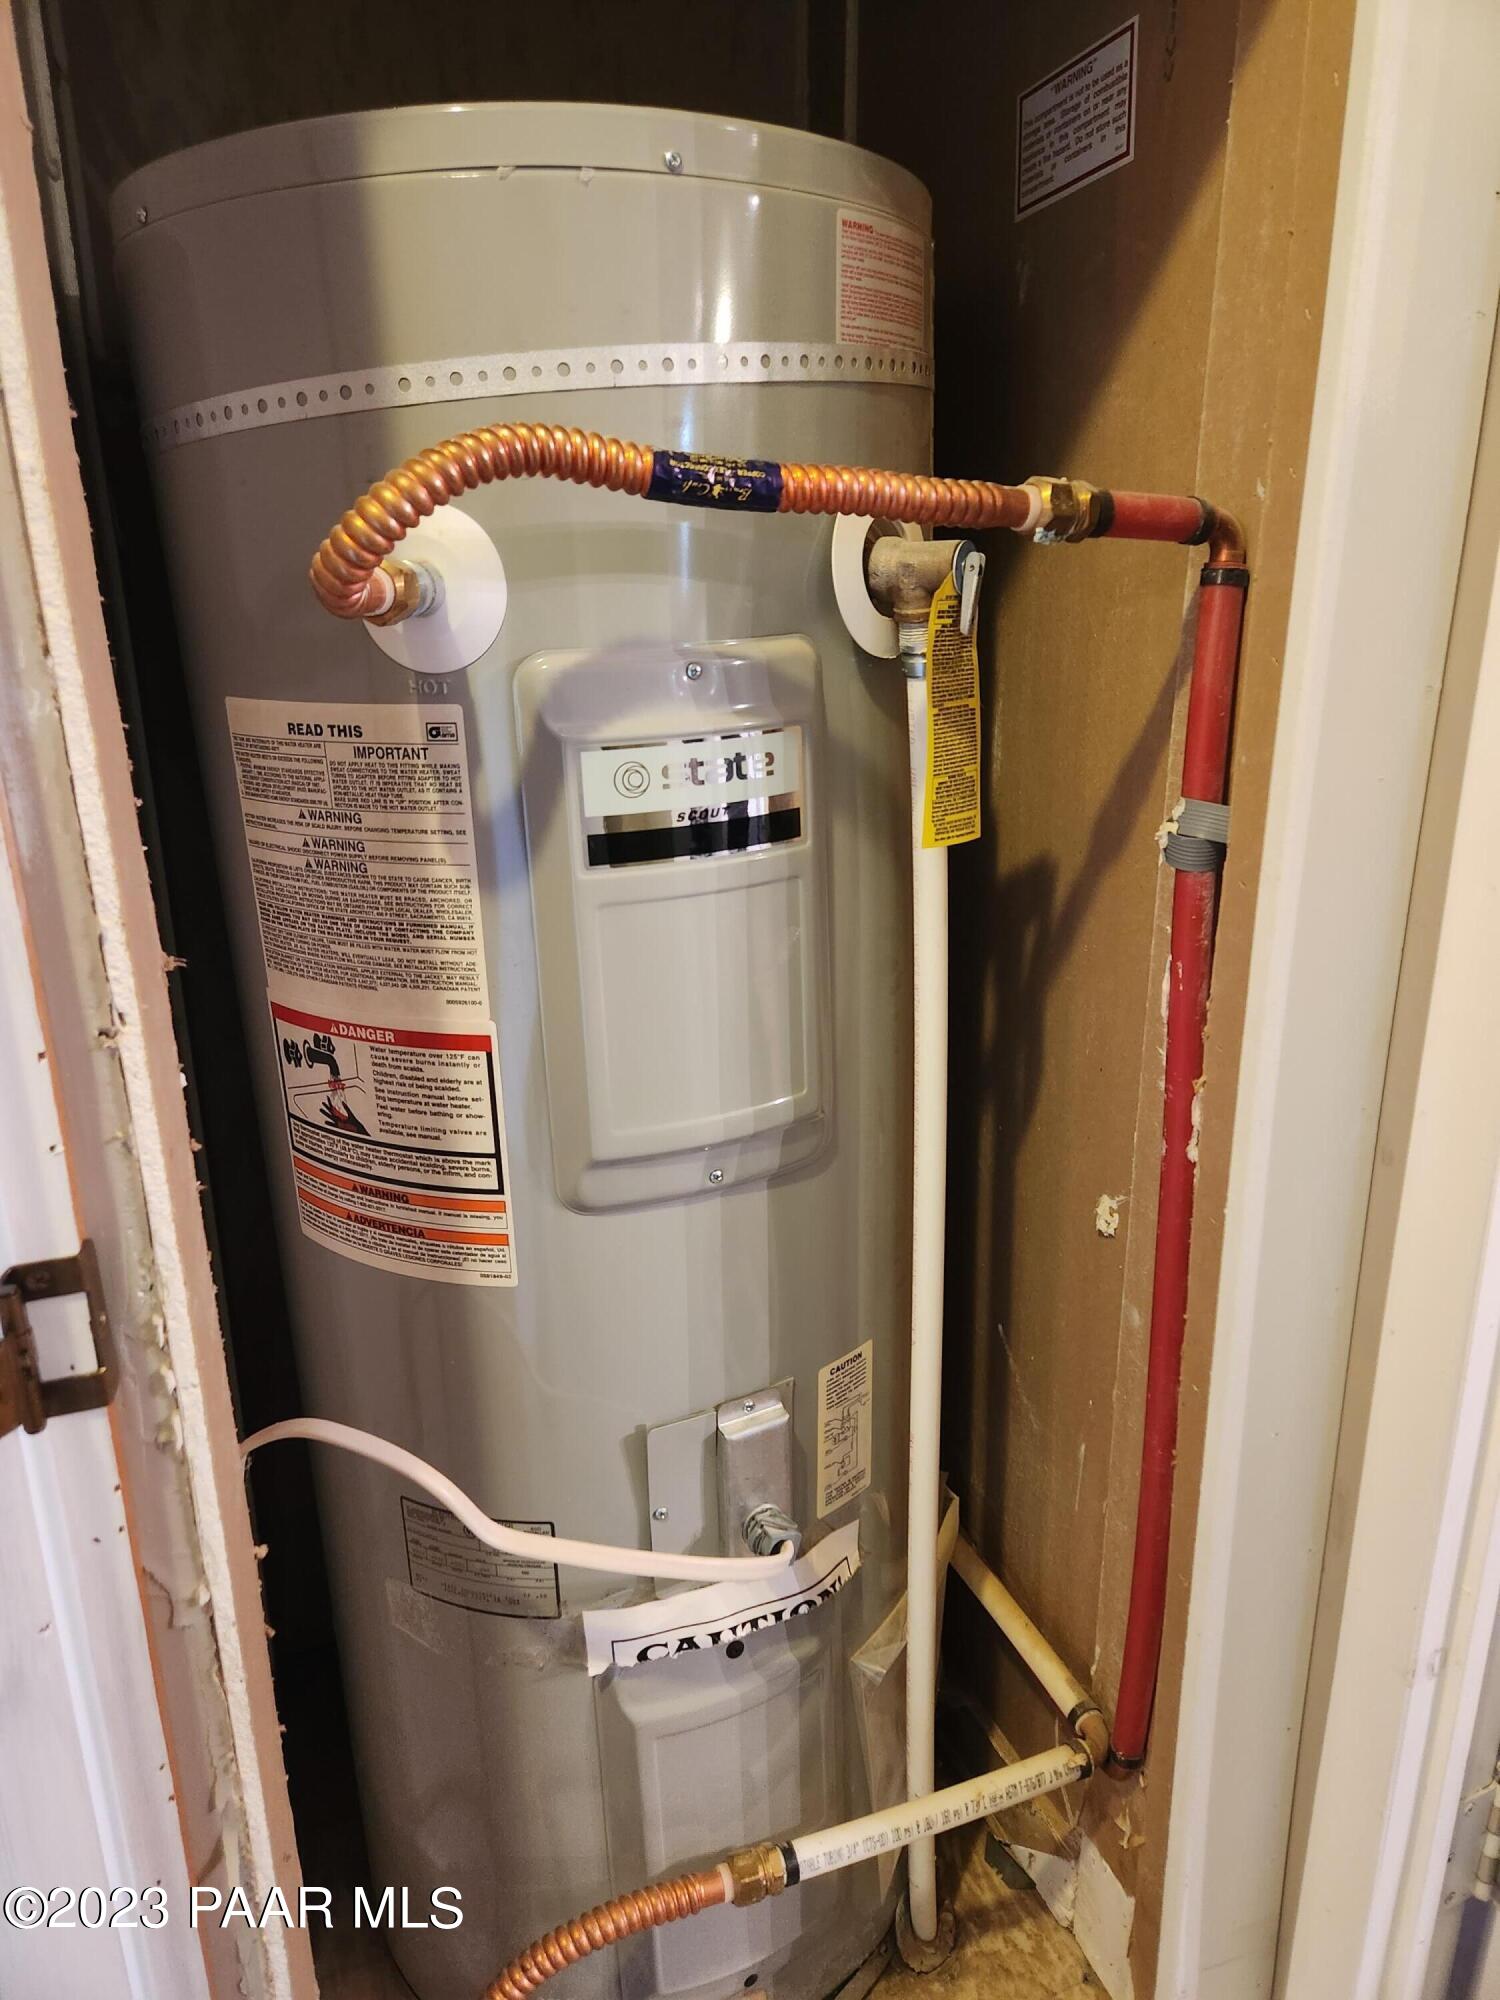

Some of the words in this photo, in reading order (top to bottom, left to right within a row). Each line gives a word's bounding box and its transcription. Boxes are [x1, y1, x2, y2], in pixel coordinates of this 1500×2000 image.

[842, 219, 874, 234] WARNING
[287, 722, 324, 737] READ
[327, 724, 363, 738] THIS
[353, 746, 429, 761] IMPORTANT
[308, 809, 362, 824] WARNING
[676, 804, 731, 823] SCOUT
[311, 837, 366, 853] WARNING
[313, 858, 368, 874] WARNING
[338, 1023, 395, 1043] DANGER
[388, 1048, 425, 1058] temperature
[392, 1056, 412, 1064] severe
[438, 1060, 469, 1068] instantly
[400, 1074, 424, 1082] disabled
[387, 1089, 419, 1098] instruction
[416, 1083, 432, 1091] being
[387, 1096, 422, 1106] temperature
[408, 1108, 427, 1116] before
[430, 1110, 453, 1119] bathing
[379, 1120, 418, 1131] Temperature
[420, 1125, 446, 1135] limiting
[359, 1184, 410, 1204] WARNING
[354, 1214, 426, 1239] ADVERTENCIA
[829, 1351, 863, 1376] CAUTION
